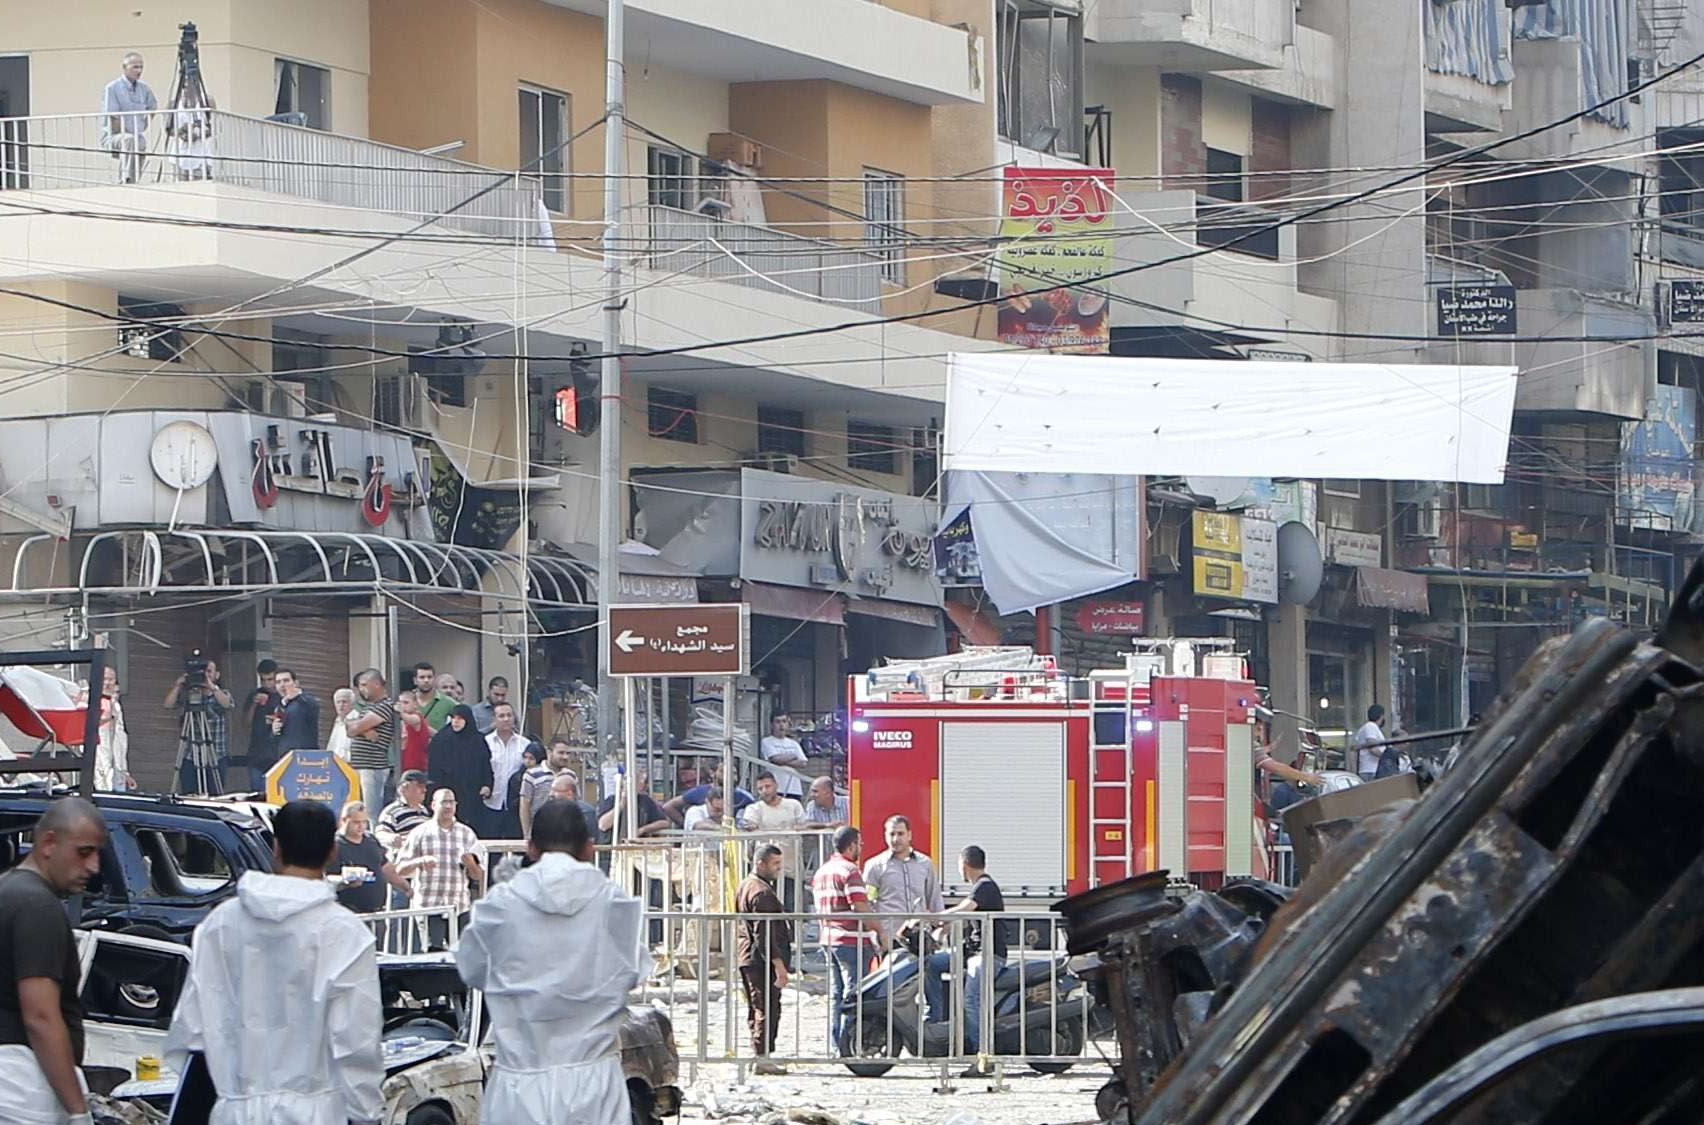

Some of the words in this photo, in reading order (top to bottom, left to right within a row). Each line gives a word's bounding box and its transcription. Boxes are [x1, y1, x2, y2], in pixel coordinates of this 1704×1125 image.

[1009, 180, 1107, 233] لذيذ
[677, 625, 709, 637] مجمع
[709, 642, 735, 654] سيد
[873, 731, 912, 741] IVECO
